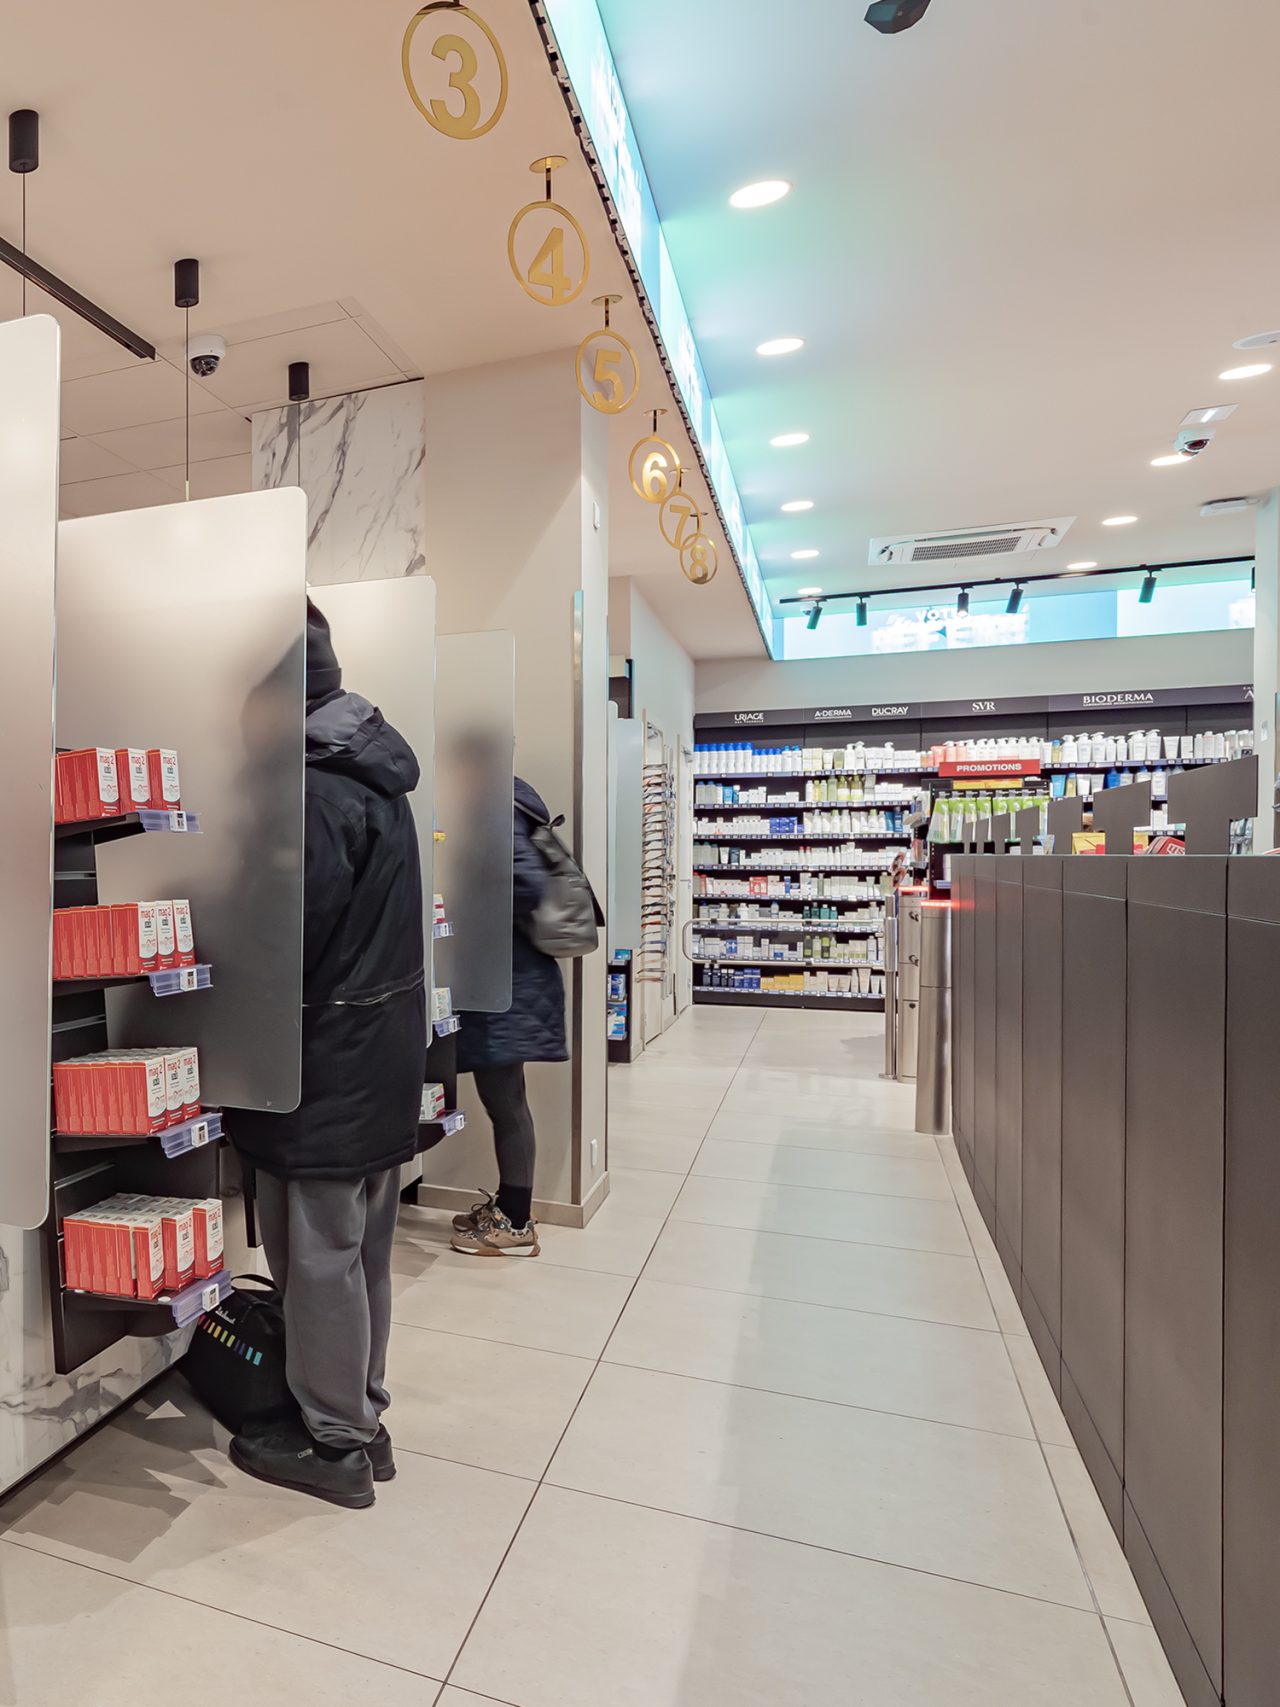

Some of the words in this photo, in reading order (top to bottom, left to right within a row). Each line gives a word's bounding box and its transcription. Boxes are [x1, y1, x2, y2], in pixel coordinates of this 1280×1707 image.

[430, 34, 481, 133] 3
[527, 227, 572, 301] 4
[593, 349, 624, 408] 5
[642, 452, 668, 500] 6
[669, 504, 691, 545] 7
[689, 545, 710, 582] 8
[972, 701, 996, 711] SVR
[1083, 692, 1154, 704] BIODERMA
[734, 712, 764, 721] URIAGE
[814, 709, 852, 718] A-DERMA
[871, 706, 909, 716] DUCRAY
[956, 762, 1022, 773] PROMOTIONS
